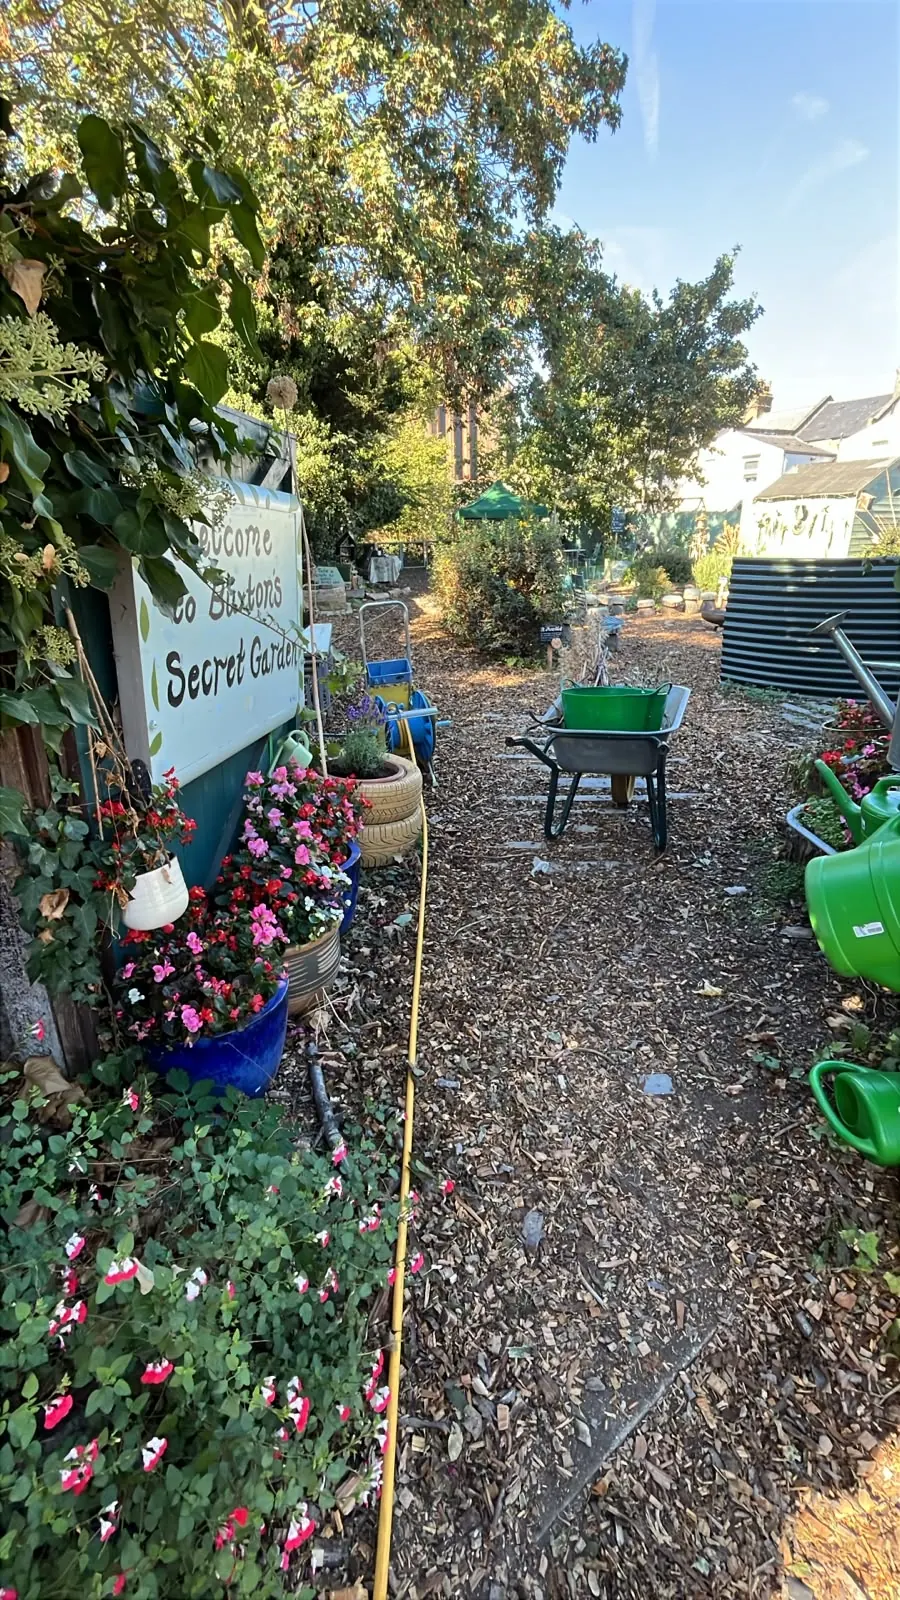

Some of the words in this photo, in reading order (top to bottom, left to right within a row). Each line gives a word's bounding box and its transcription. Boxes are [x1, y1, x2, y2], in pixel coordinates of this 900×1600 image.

[182, 513, 273, 560] elcome
[166, 637, 245, 708] Secret
[250, 635, 297, 678] Garden
